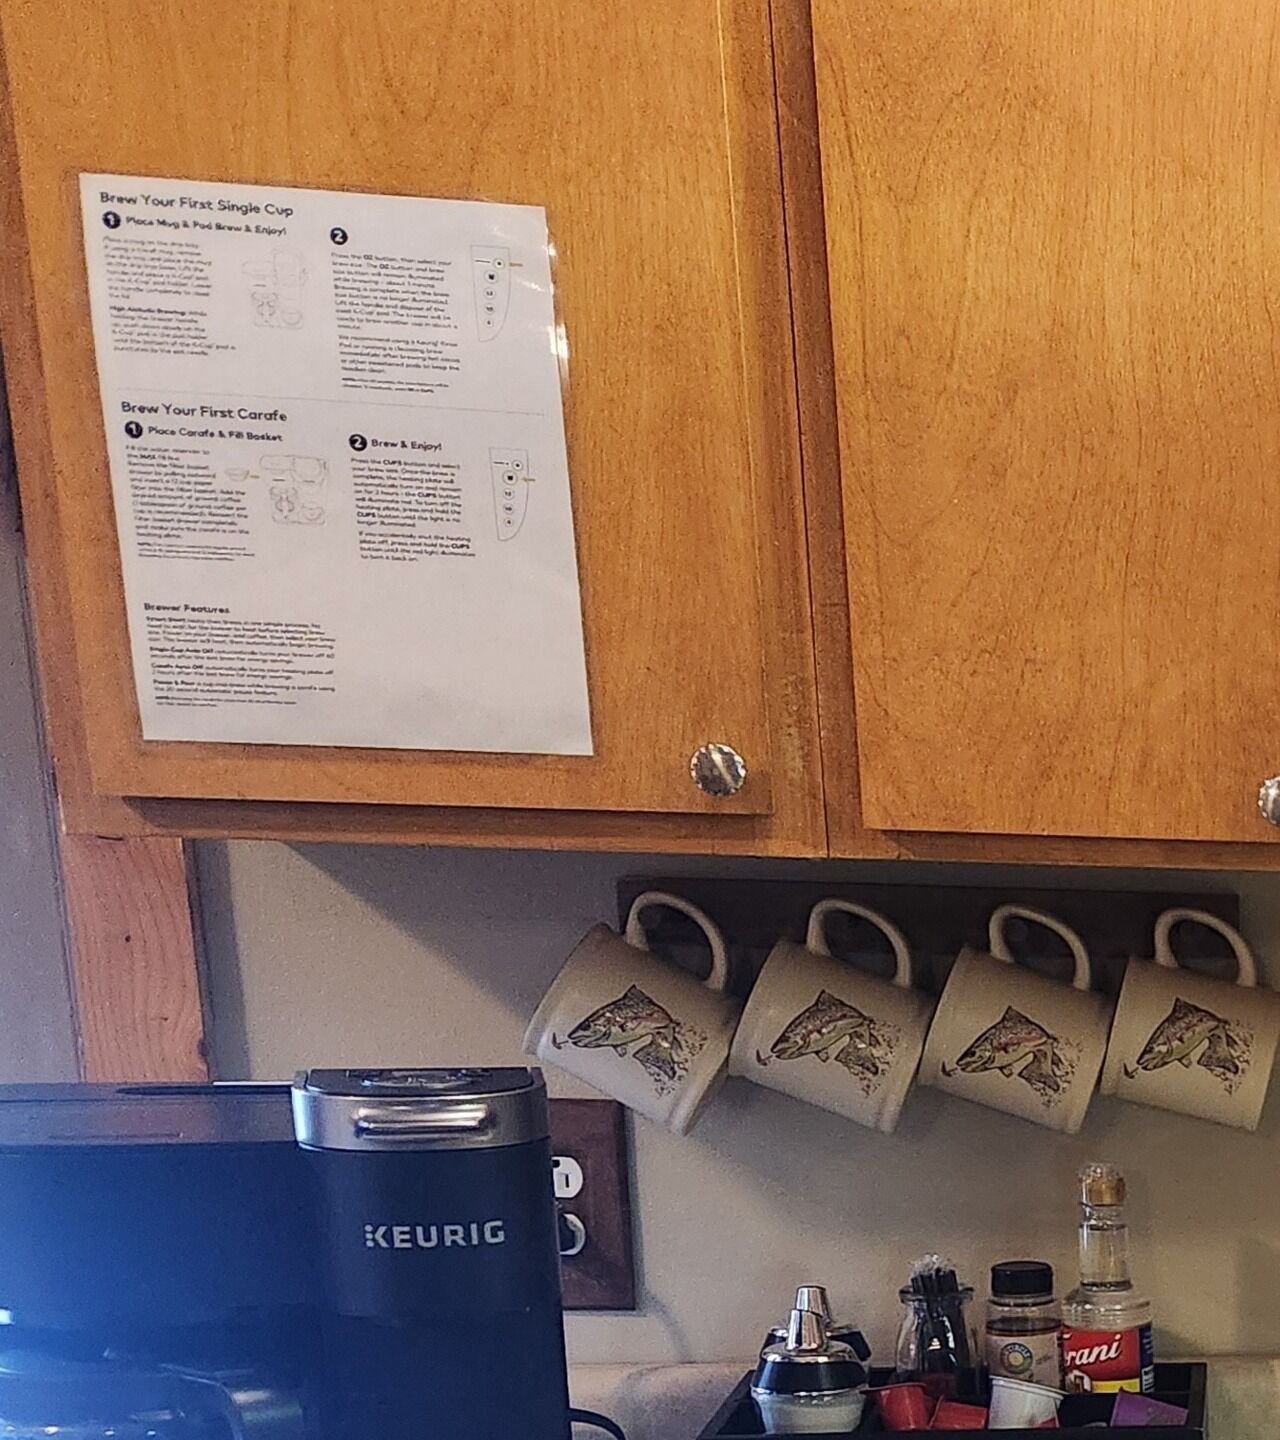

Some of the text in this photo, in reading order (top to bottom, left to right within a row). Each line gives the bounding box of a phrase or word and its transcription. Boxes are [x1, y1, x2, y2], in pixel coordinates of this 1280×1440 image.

[98, 191, 293, 218] Brew Your First Single Cup
[214, 222, 242, 231] Brew
[254, 224, 286, 236] Enjoy!
[120, 400, 287, 421] Brew Your First Carafe
[147, 425, 176, 435] Place
[178, 427, 215, 438] Carafe
[245, 431, 283, 442] Basket
[370, 438, 398, 447] Brew
[410, 440, 442, 452] Enjoy!
[143, 602, 230, 614] Brewer Features
[364, 1220, 505, 1248] KEURIG
[1064, 1333, 1122, 1367] rani
